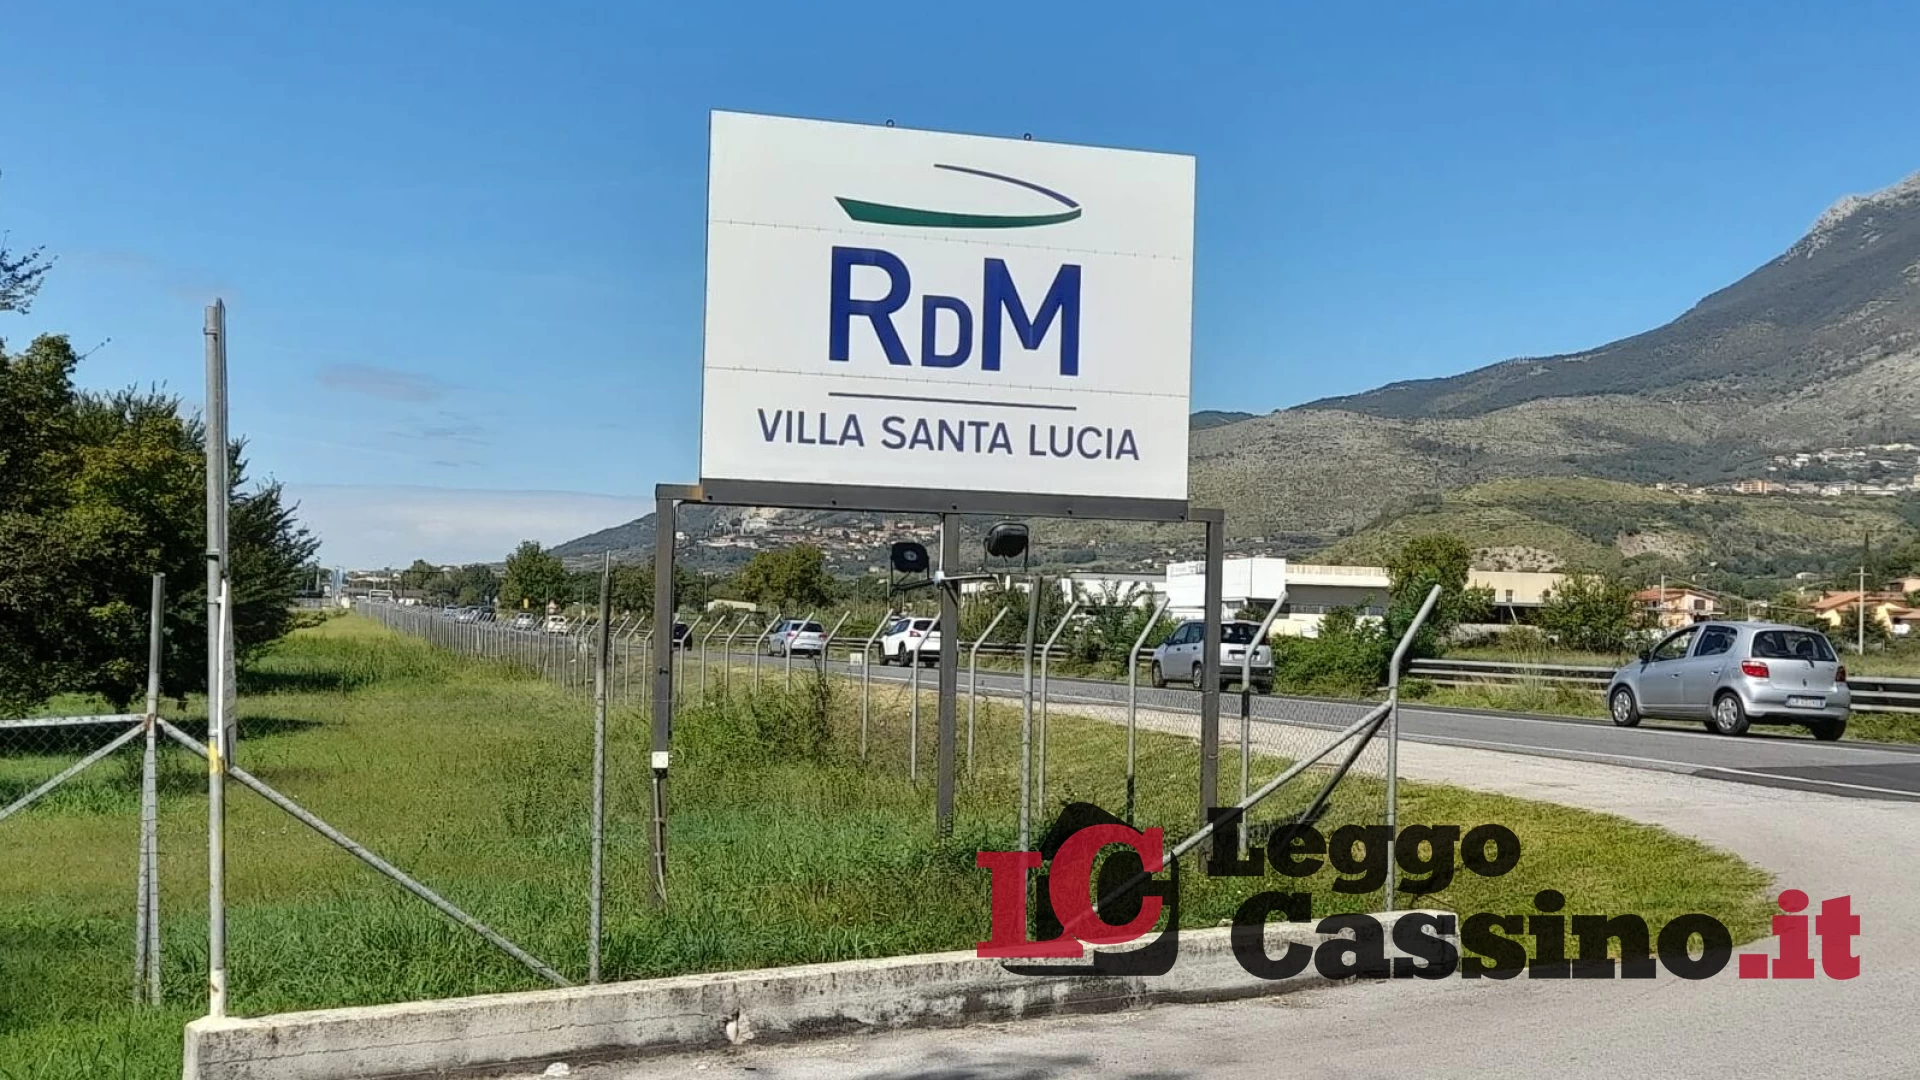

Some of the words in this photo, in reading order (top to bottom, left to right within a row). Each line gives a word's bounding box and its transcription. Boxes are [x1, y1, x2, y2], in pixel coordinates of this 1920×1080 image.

[757, 408, 865, 447] VILLA
[881, 416, 1013, 455] SANTA
[1029, 424, 1140, 461] LUCIA
